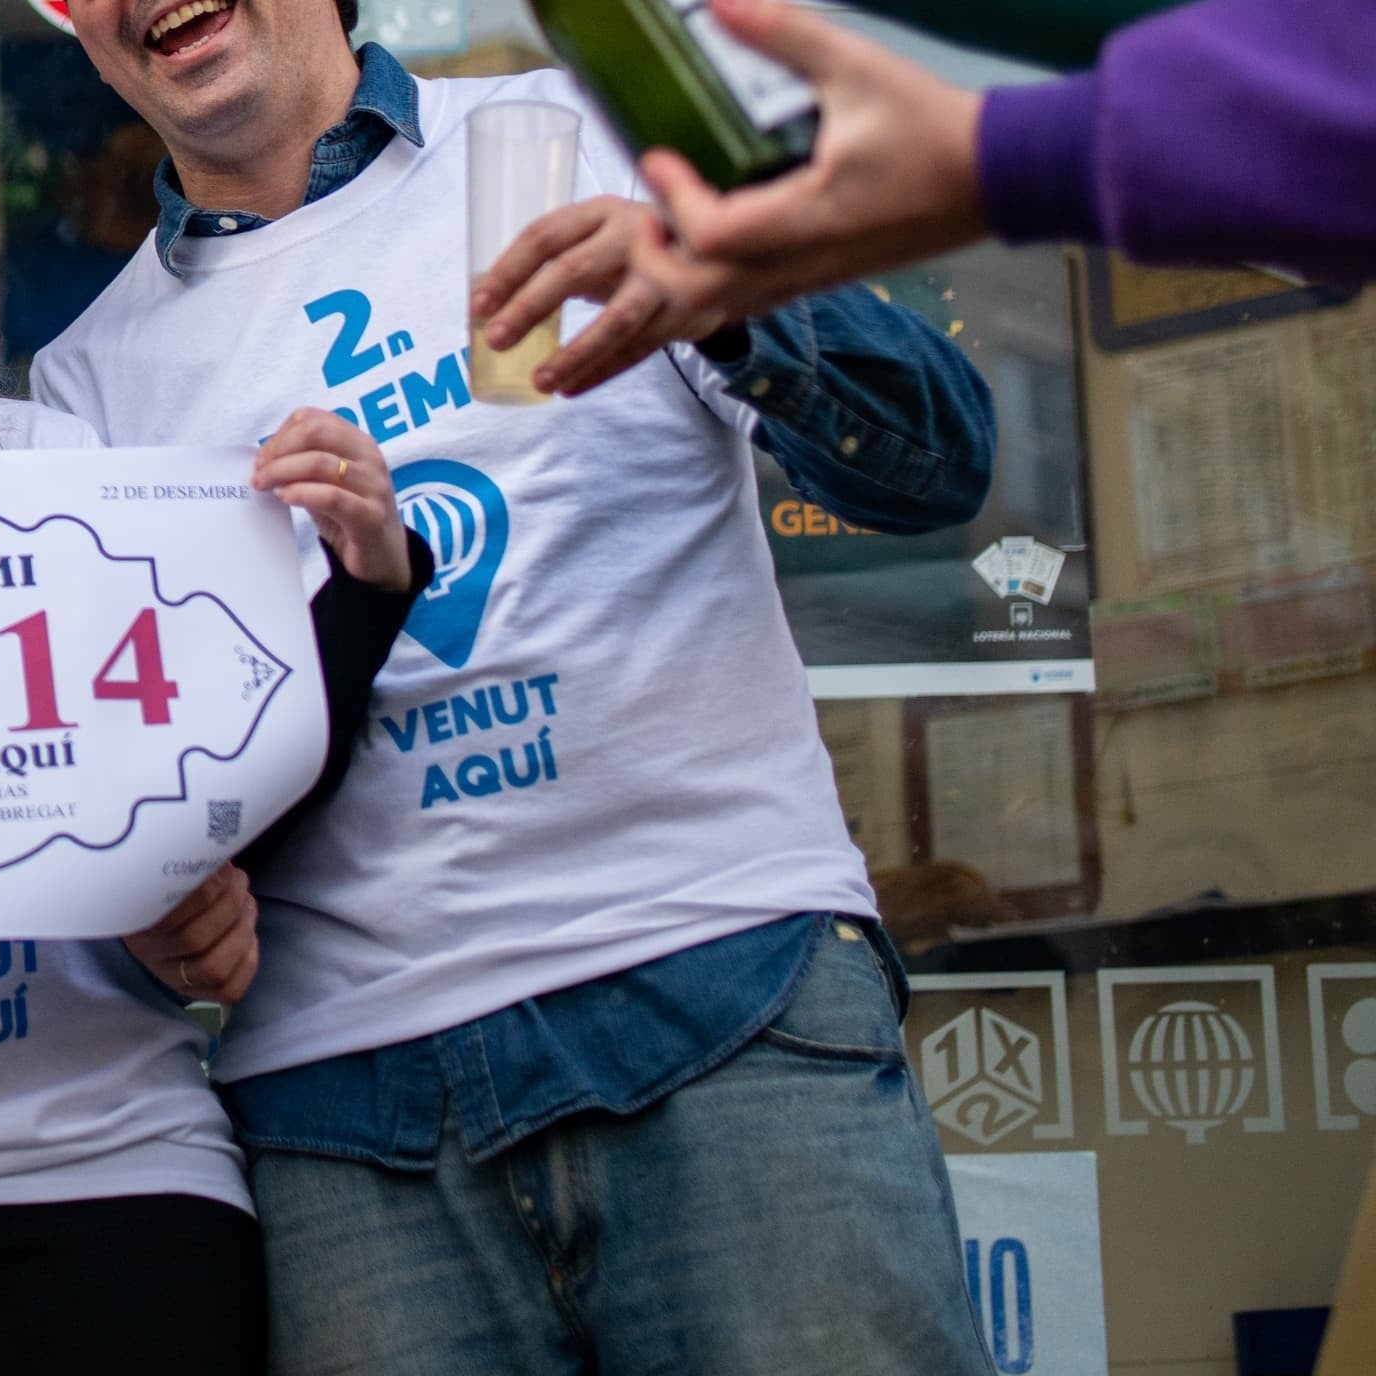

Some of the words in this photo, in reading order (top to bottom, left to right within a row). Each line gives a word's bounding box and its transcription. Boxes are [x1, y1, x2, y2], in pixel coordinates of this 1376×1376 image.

[99, 485, 119, 500] 22
[123, 485, 149, 500] DE
[153, 484, 250, 500] DESEMBRE
[378, 672, 559, 753] VENUT
[420, 725, 559, 810] AQUÍ
